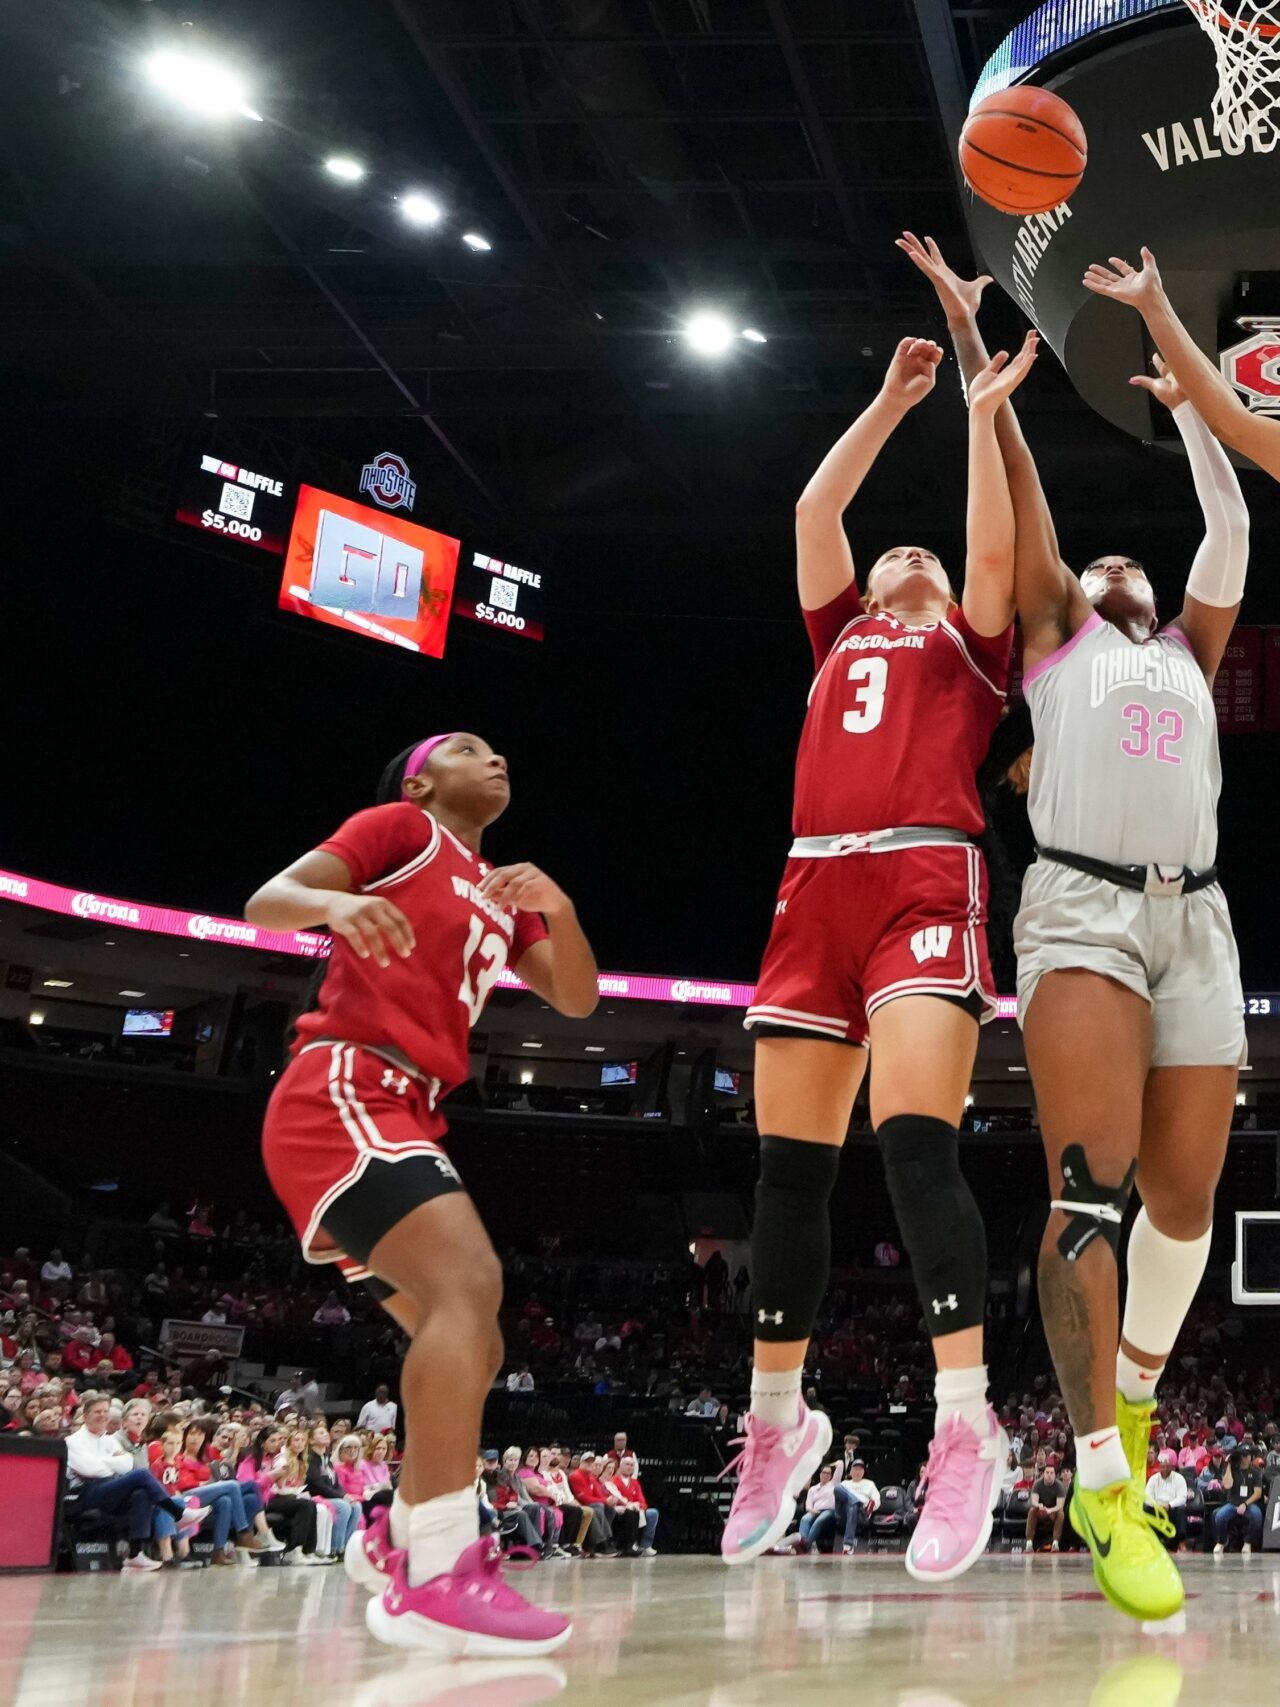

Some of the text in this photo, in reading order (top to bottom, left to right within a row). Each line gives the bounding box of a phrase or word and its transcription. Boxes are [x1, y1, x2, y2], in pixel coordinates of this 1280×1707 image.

[1141, 110, 1271, 172] VALUE
[1014, 200, 1073, 278] ARENA
[237, 468, 283, 497] RAFFLE
[201, 509, 262, 541] $5,000
[311, 509, 424, 621] GO
[503, 563, 541, 588] RAFFLE
[475, 602, 525, 630] $5,000
[843, 656, 888, 734] 3
[1120, 702, 1184, 765] 32
[71, 893, 140, 922] Corona
[187, 915, 256, 943] Corona
[910, 925, 953, 964] W
[671, 980, 732, 1002] Corona
